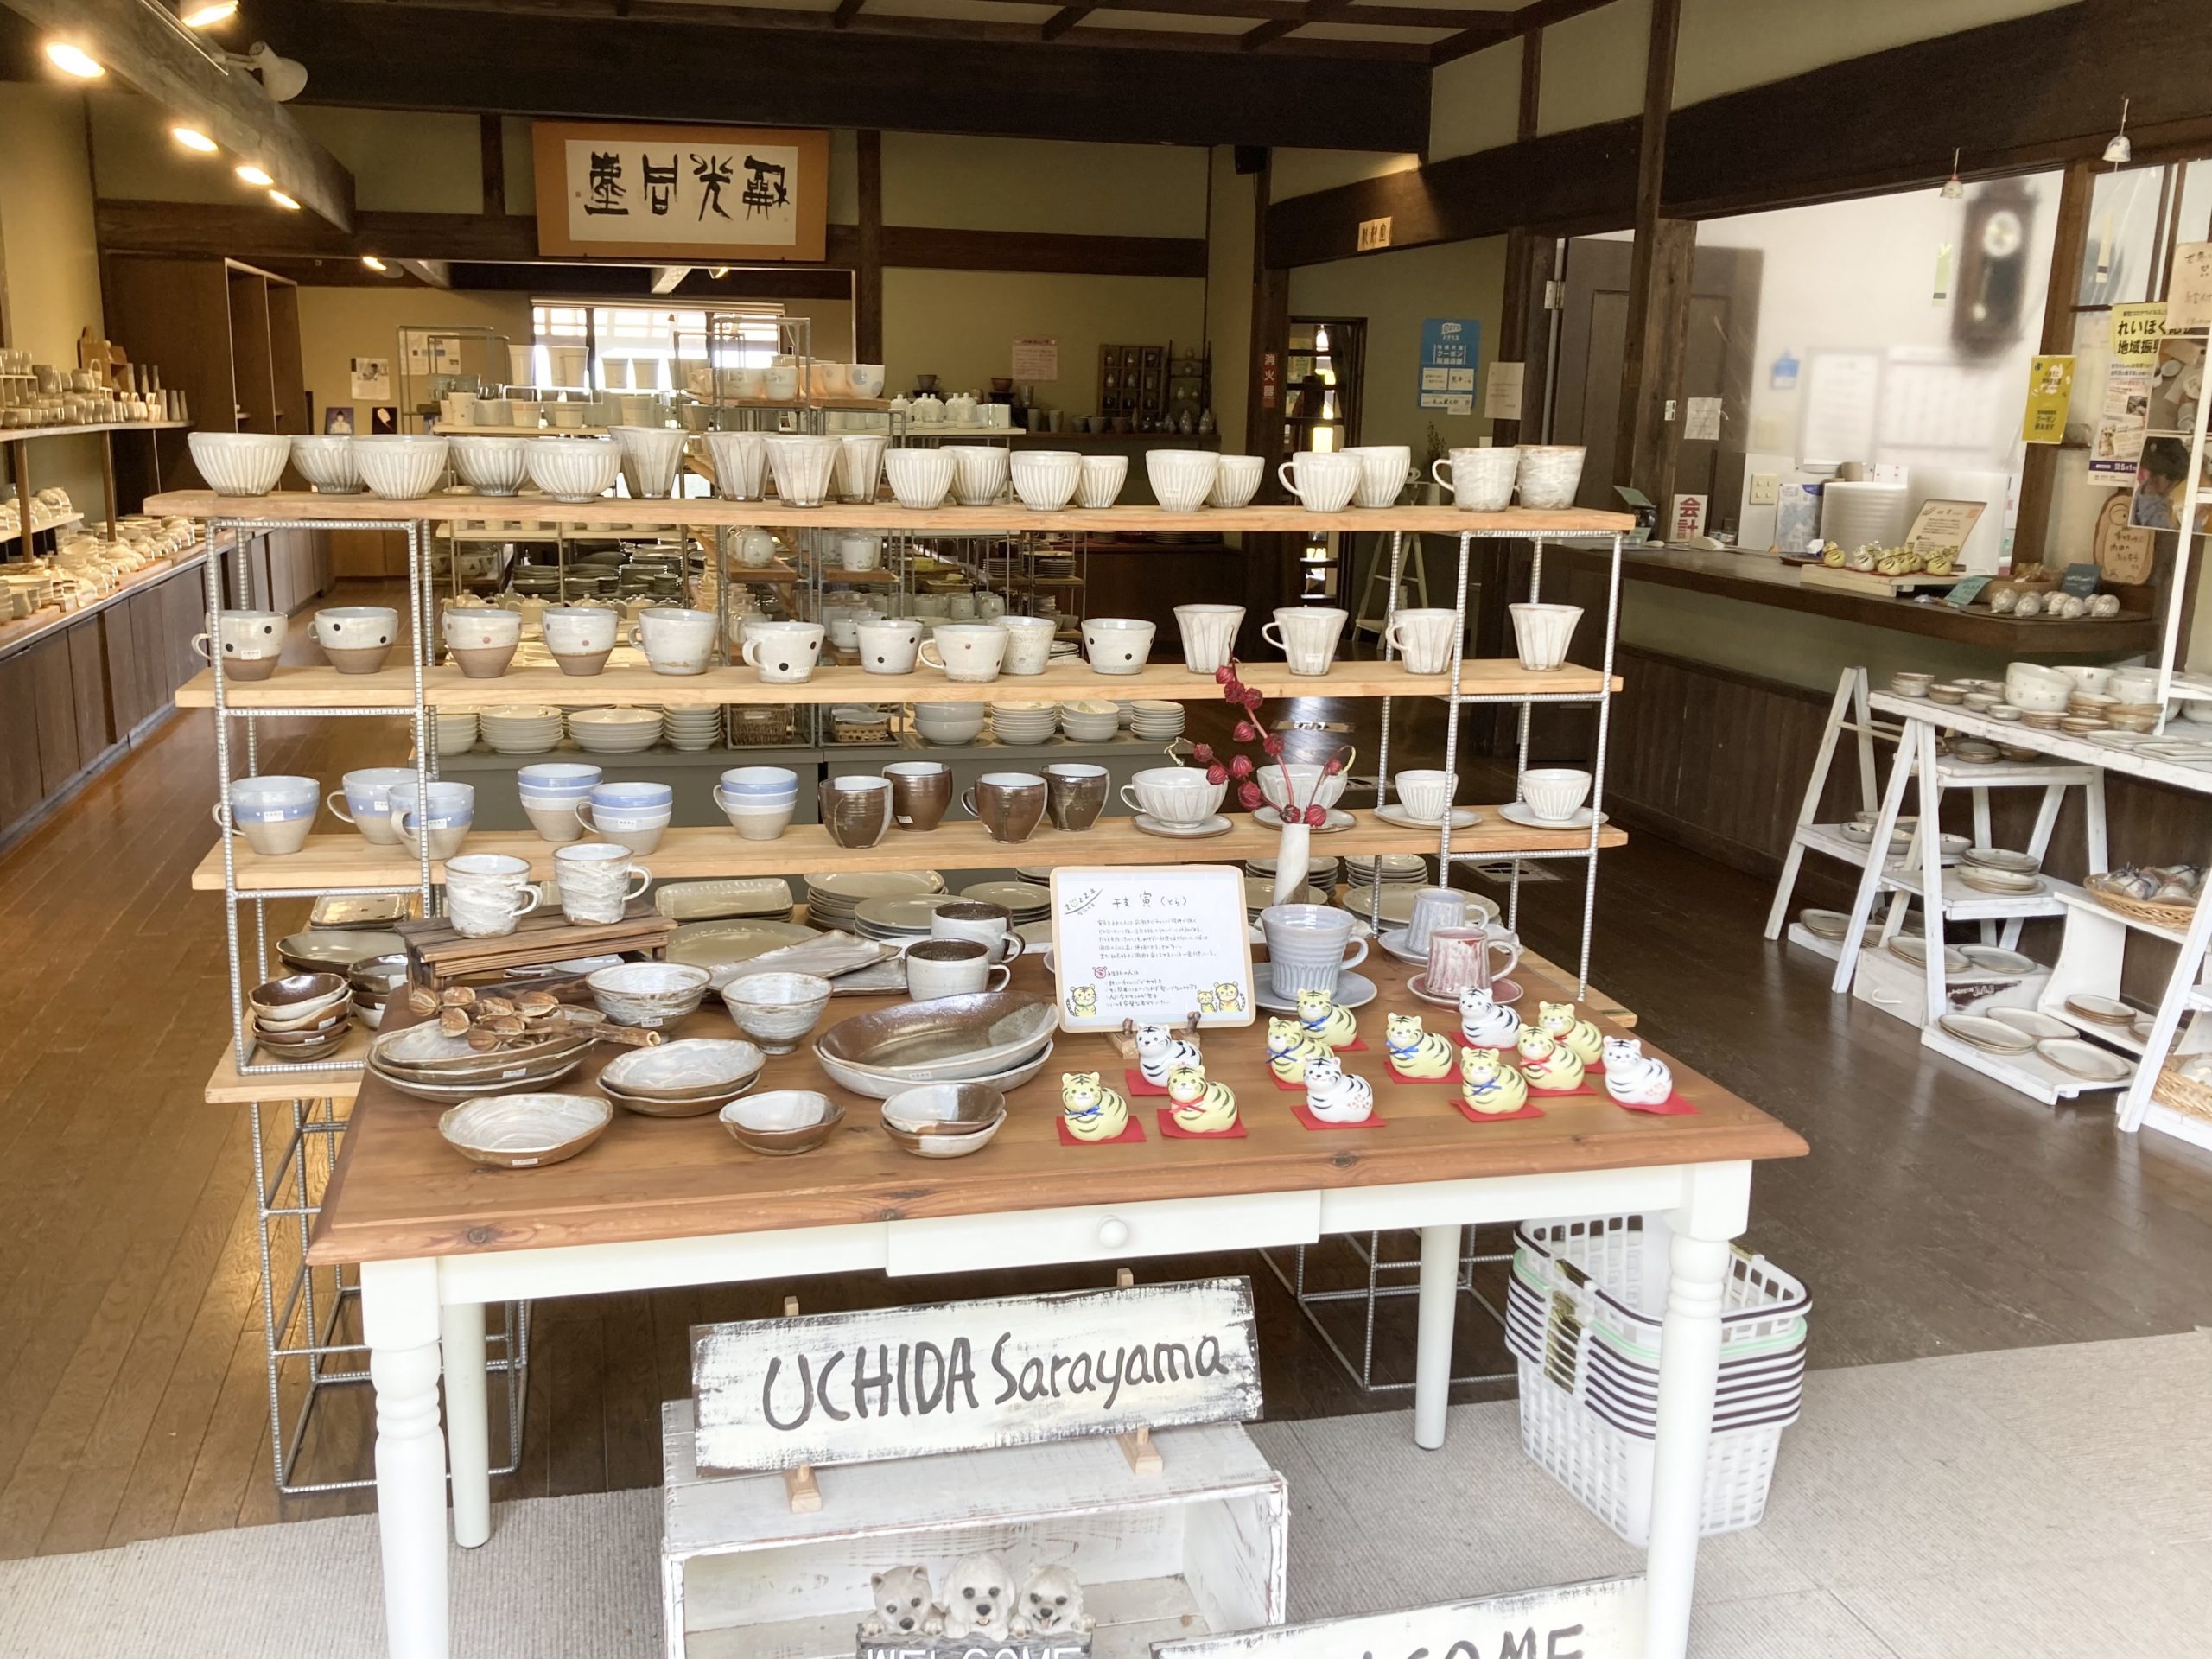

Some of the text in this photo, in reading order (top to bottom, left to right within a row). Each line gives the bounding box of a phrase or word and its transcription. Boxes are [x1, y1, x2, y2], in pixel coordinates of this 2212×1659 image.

[1676, 497, 1701, 540] 会計
[763, 1331, 1230, 1431] UCHIDA Sarayama
